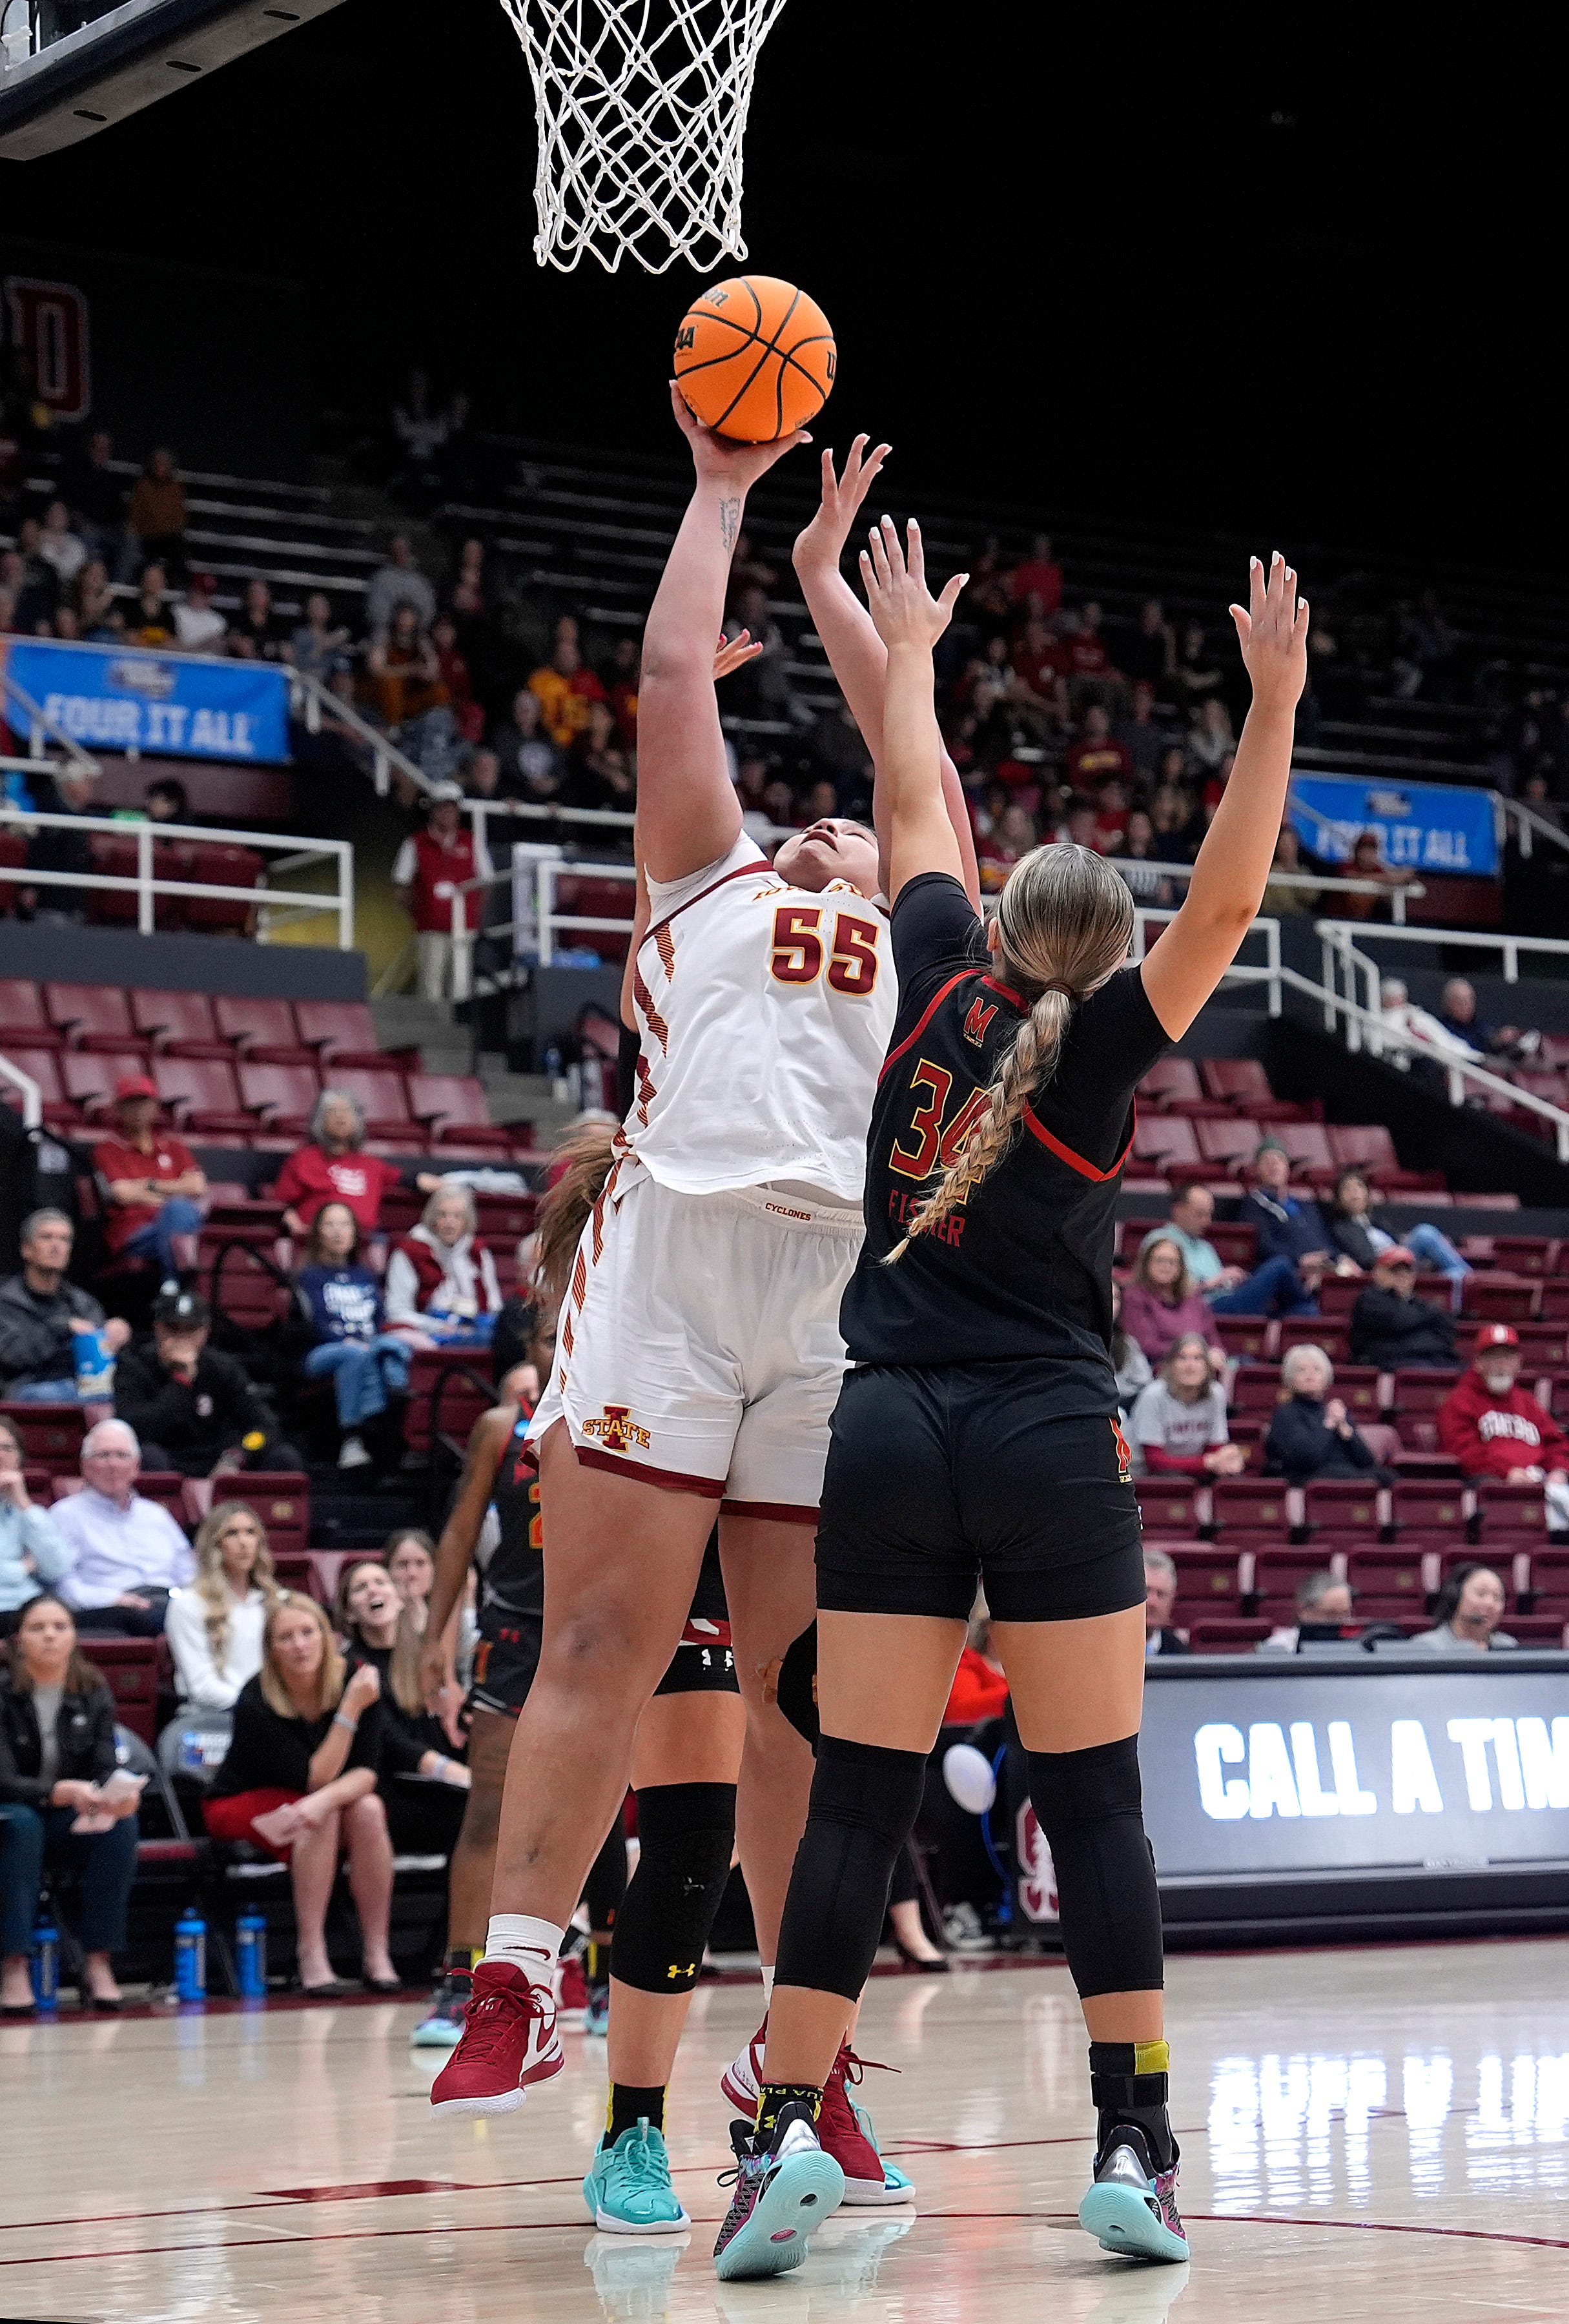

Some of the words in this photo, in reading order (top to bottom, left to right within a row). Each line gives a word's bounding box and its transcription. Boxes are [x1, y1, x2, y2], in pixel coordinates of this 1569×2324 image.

[770, 906, 879, 996] 55
[963, 996, 999, 1043] M
[888, 1057, 994, 1205] 34
[765, 1202, 812, 1221] CYCLONES
[582, 1418, 651, 1449] STATE
[1195, 1722, 1377, 1820] CALL
[1391, 1720, 1444, 1813] A
